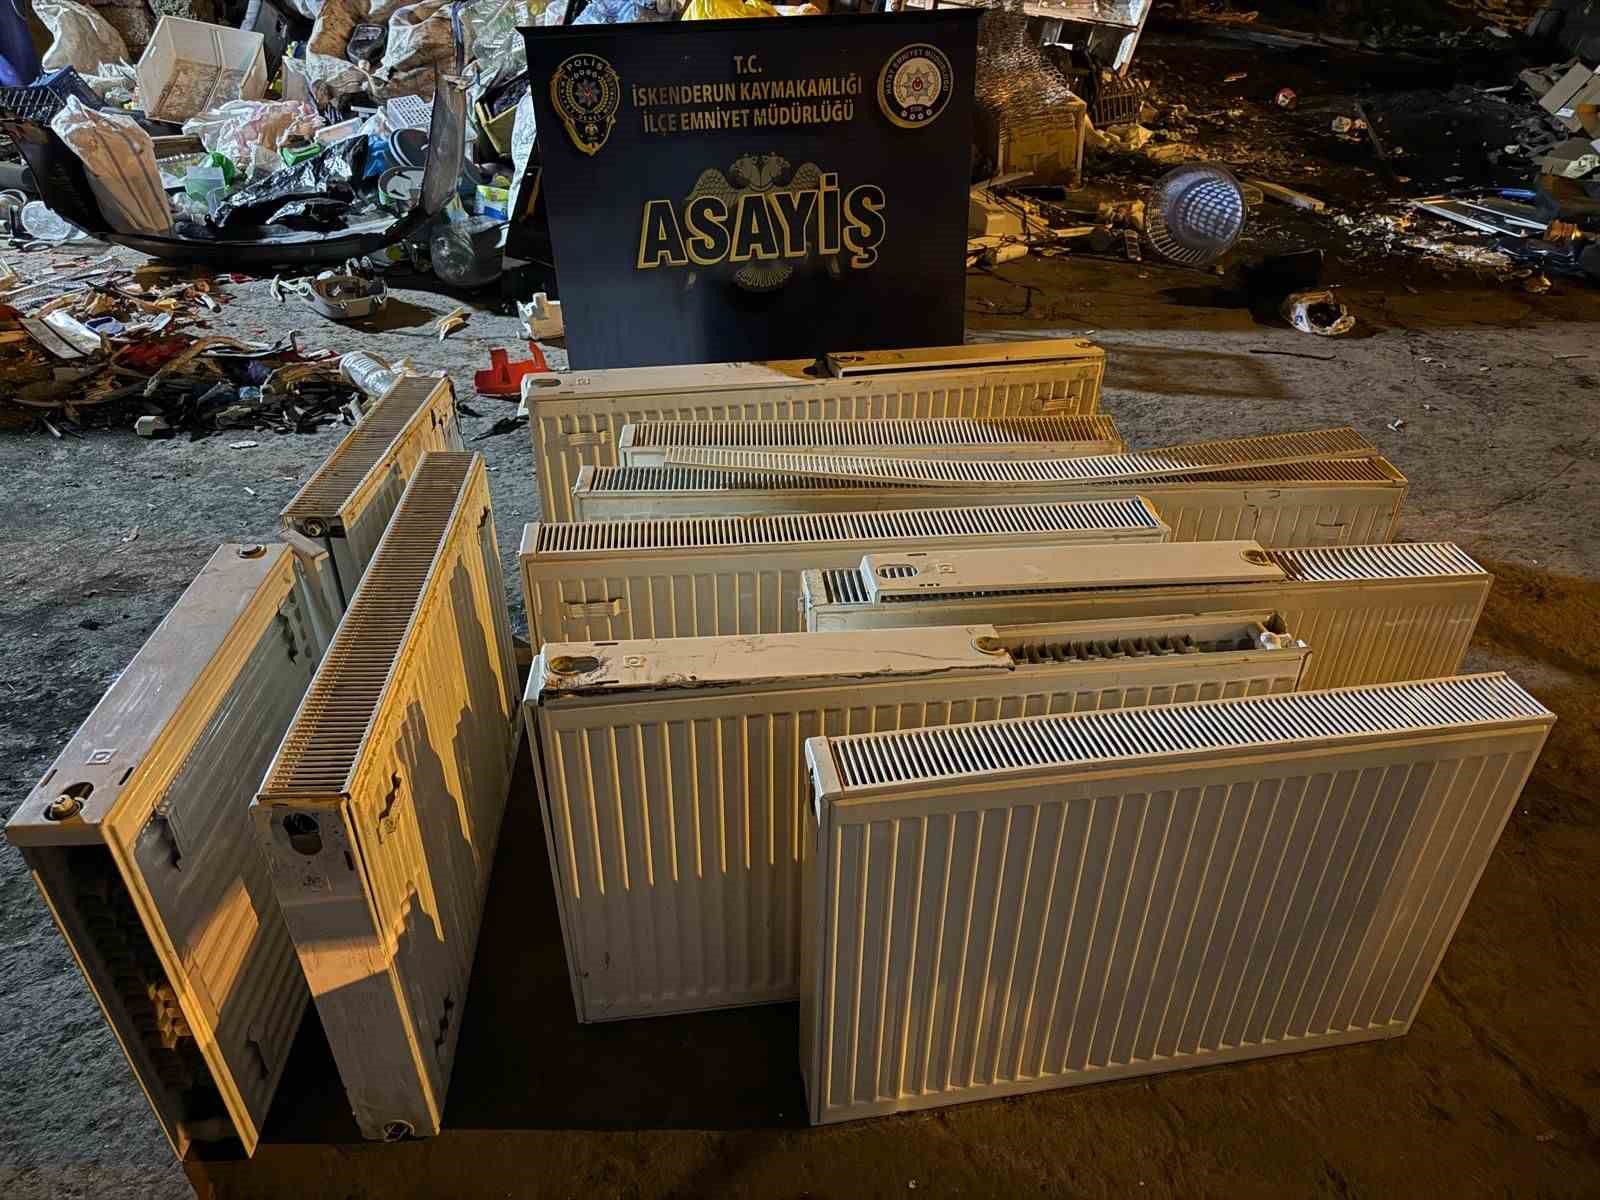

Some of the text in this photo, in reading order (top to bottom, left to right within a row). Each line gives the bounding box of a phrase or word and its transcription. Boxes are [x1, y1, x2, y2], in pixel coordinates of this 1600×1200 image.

[733, 55, 762, 74] T.C.
[632, 83, 737, 107] İSKENDERUN
[740, 73, 862, 100] KAYMAKAMLIĞI
[643, 99, 854, 136] İLÇE EMNİYET MÜDÜRLÜĞÜ
[637, 172, 887, 269] ASAYİŞ
